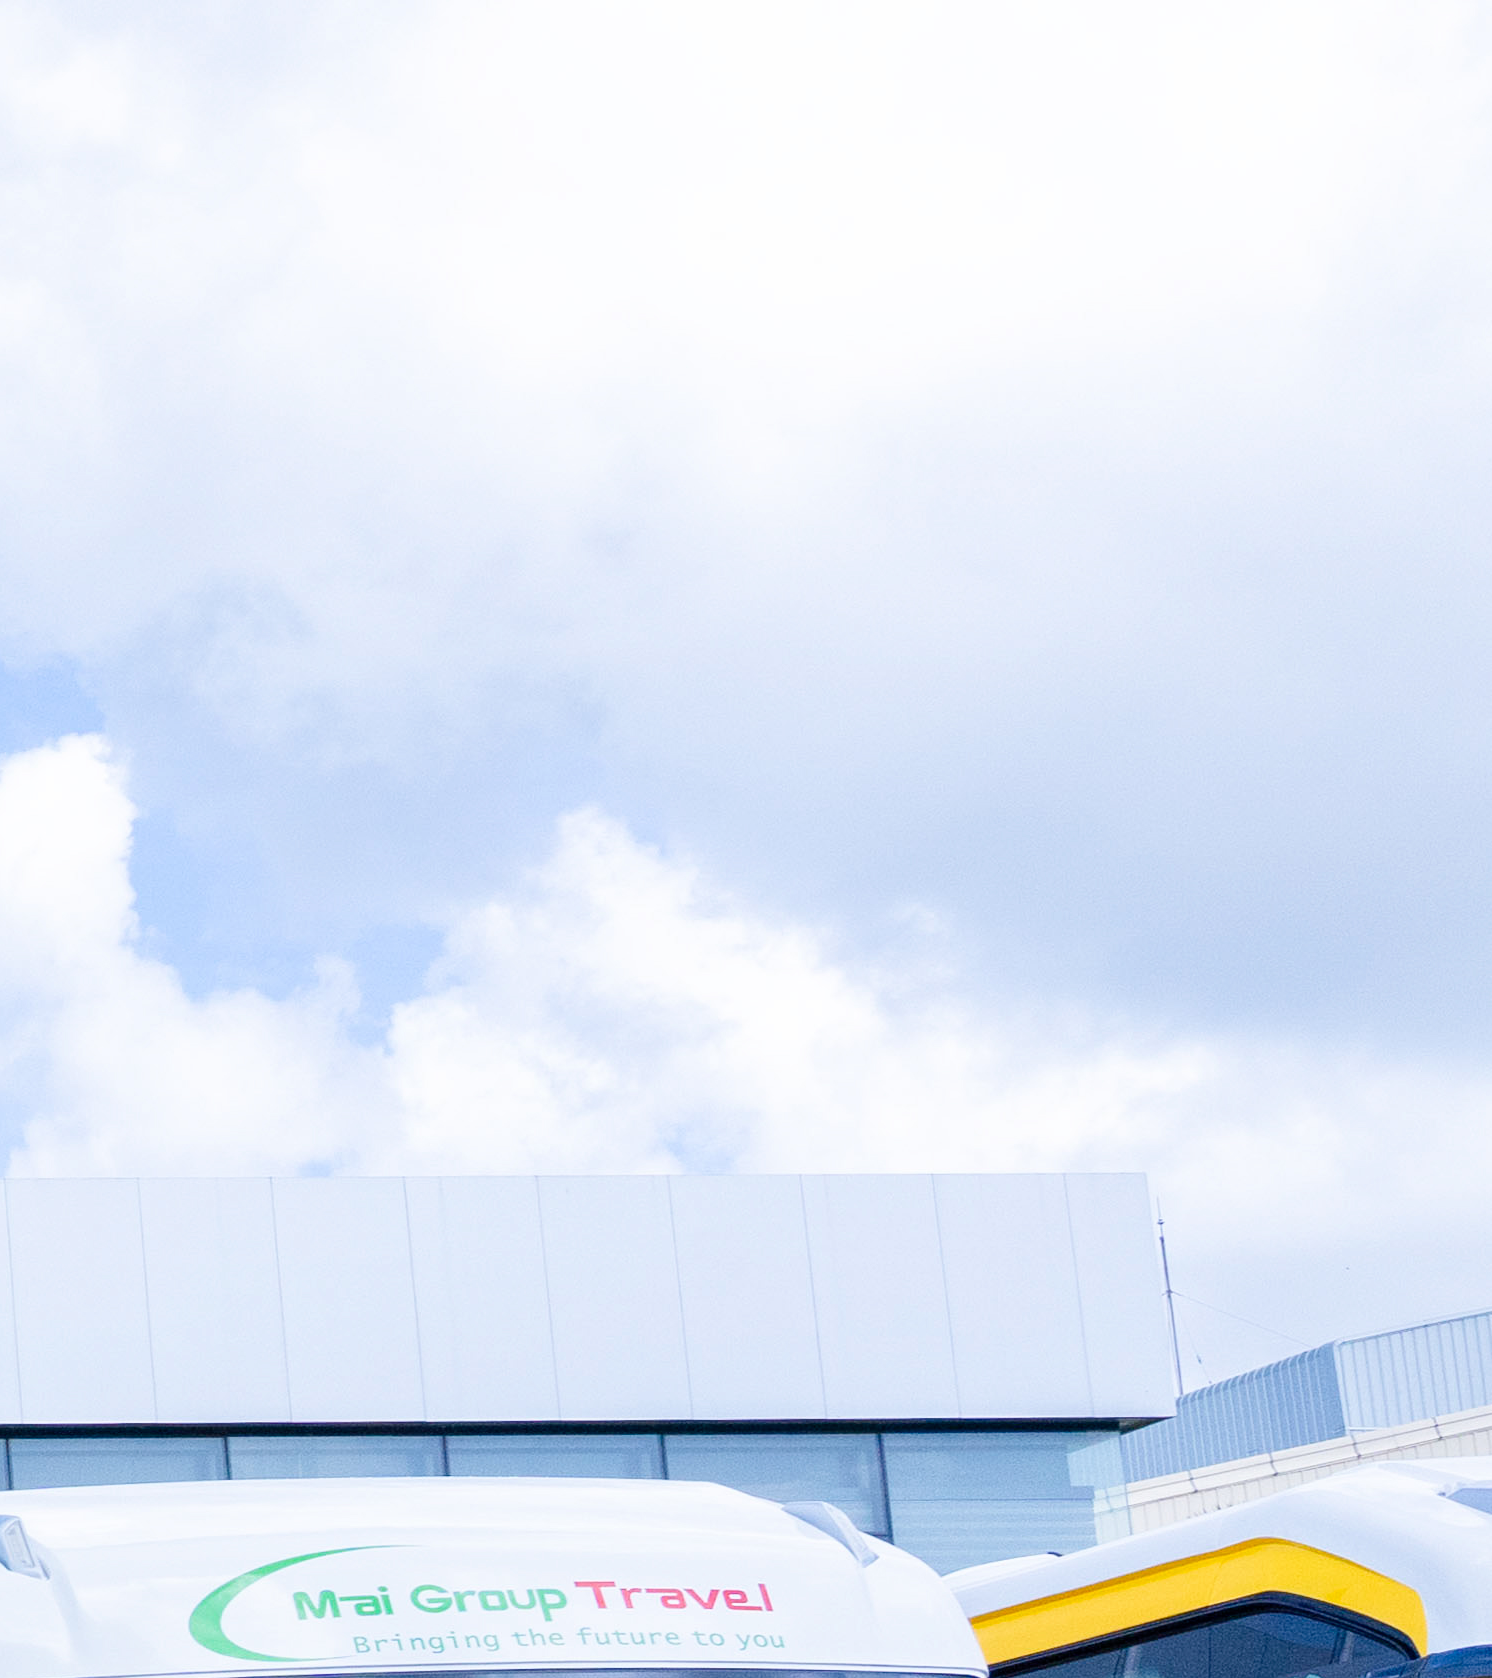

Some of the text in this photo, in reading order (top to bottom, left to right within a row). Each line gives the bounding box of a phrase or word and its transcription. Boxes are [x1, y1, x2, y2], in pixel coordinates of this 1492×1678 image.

[410, 1585, 567, 1622] Group
[574, 1581, 773, 1611] Travel
[353, 1627, 785, 1653] Bringing the future to you
